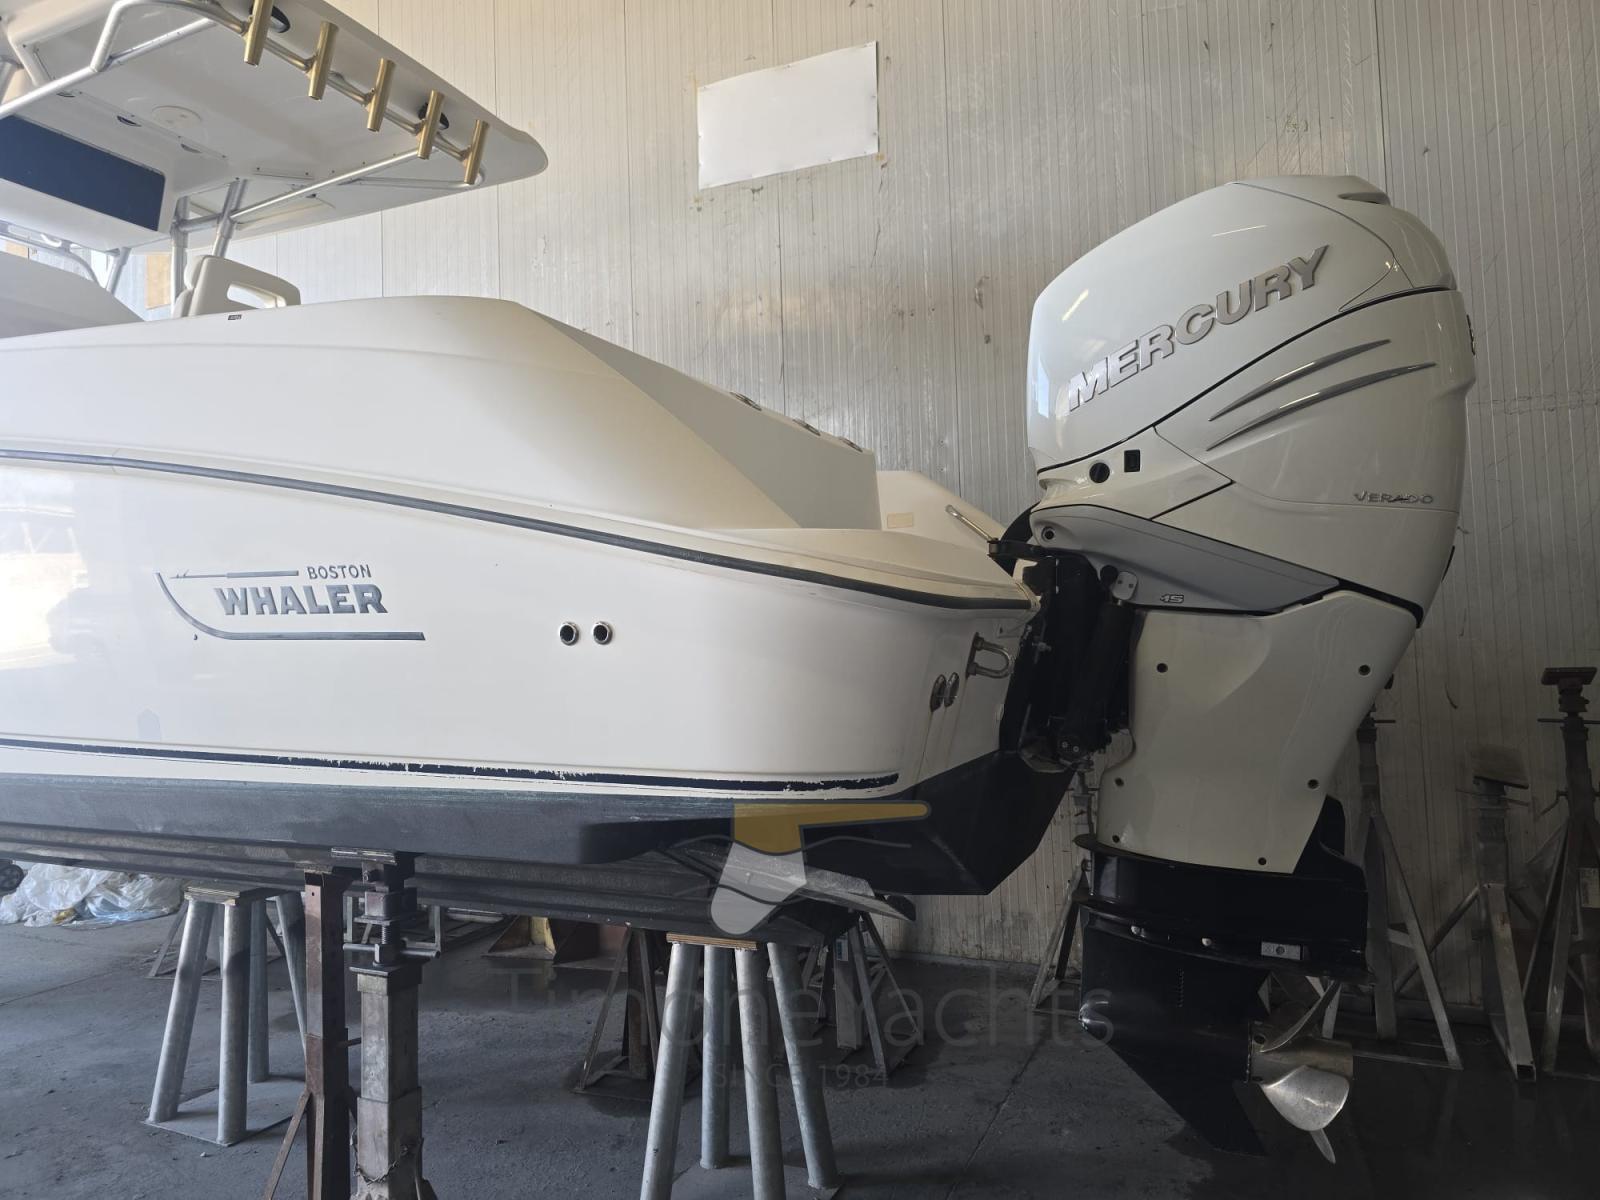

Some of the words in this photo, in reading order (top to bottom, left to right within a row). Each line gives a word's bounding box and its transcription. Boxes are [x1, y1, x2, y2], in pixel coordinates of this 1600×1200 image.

[1068, 244, 1330, 412] MERCURY
[1353, 491, 1433, 504] VERADO
[306, 564, 372, 580] BOSTON
[213, 584, 389, 615] WHALER
